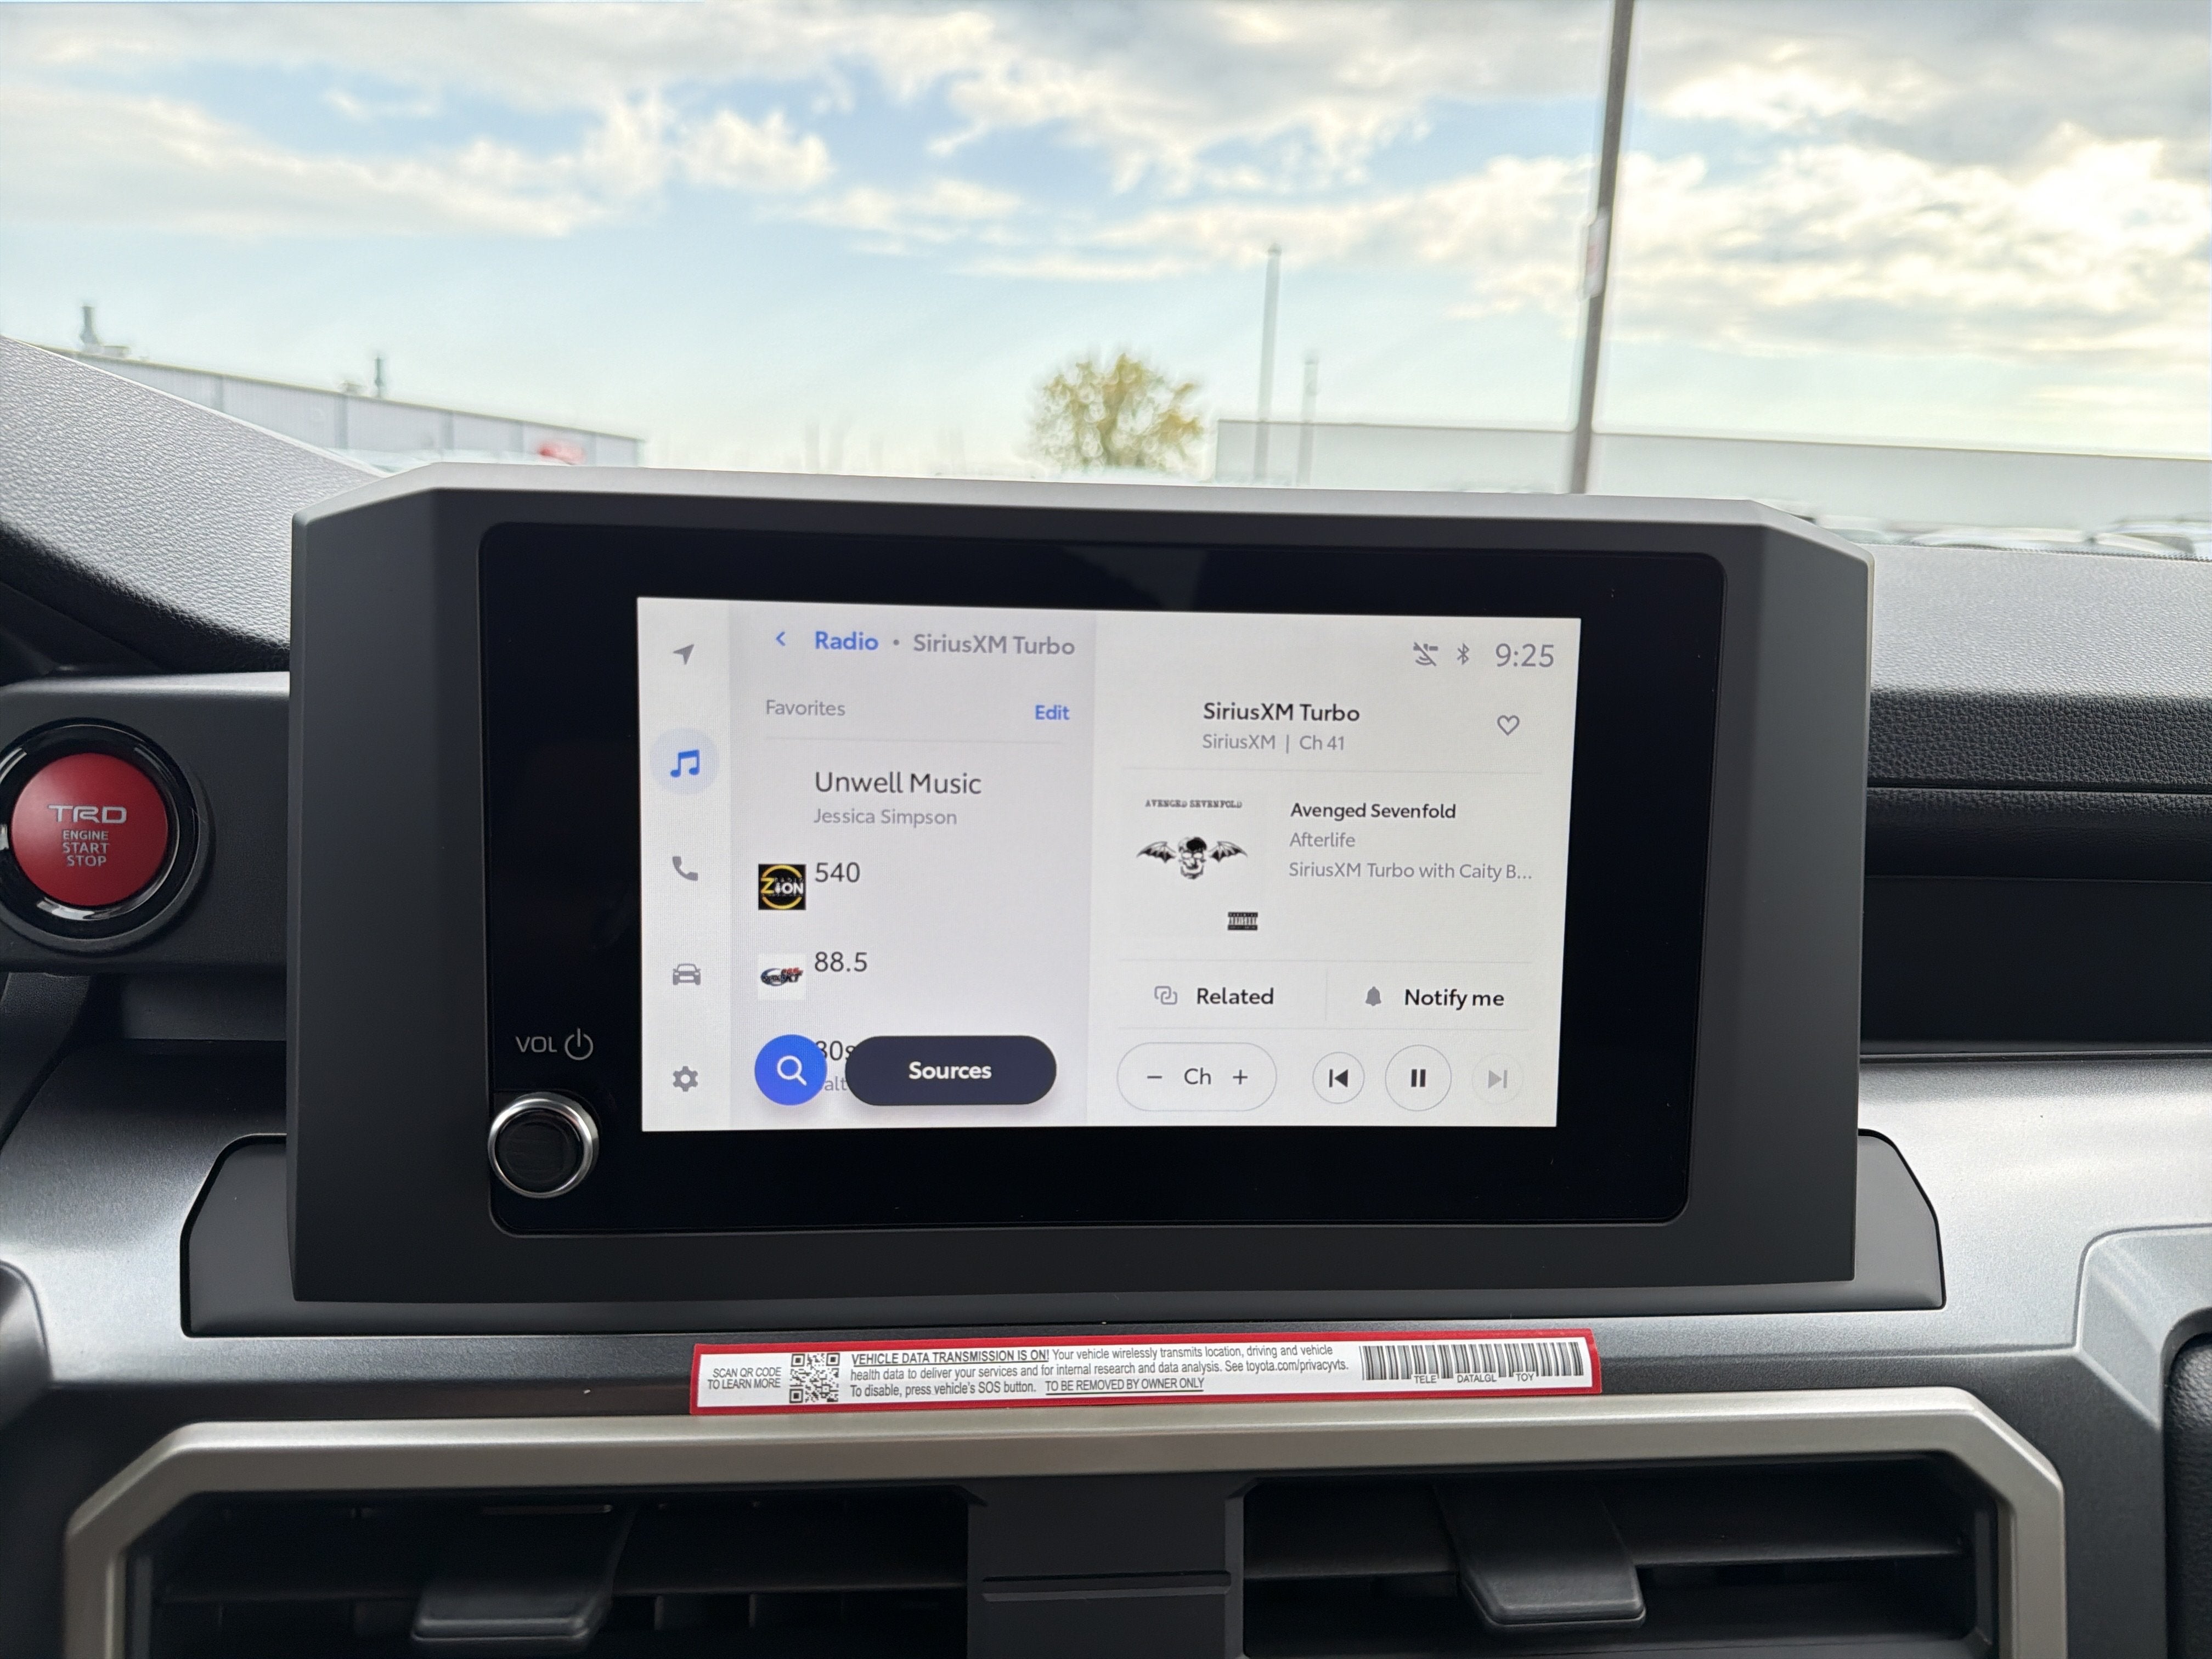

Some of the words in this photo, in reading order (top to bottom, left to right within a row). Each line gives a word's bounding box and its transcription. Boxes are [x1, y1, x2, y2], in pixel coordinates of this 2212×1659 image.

[815, 631, 879, 651] Radio
[913, 634, 1007, 654] SiriusXM
[1013, 636, 1075, 656] Turbo
[1495, 642, 1555, 668] 9:25
[766, 699, 846, 717] Favorites
[1035, 704, 1070, 721] Edit
[1203, 702, 1294, 722] SiriusXM
[1300, 703, 1360, 723] Turbo
[1202, 733, 1276, 751] SiriusXM
[1299, 735, 1324, 752] Ch
[1325, 735, 1345, 752] 41
[815, 771, 904, 794] Unwell
[910, 774, 982, 795] Music
[48, 804, 127, 824] TRD
[814, 808, 876, 825] Jessica
[880, 809, 958, 827] Simpson
[1290, 803, 1367, 820] Avenged
[1371, 803, 1457, 820] Sevenfold
[63, 830, 109, 841] ENGINE
[1289, 832, 1356, 848] Afterlife
[63, 842, 110, 854] START
[66, 855, 106, 867] STOP
[815, 862, 860, 884] 540
[1289, 862, 1362, 879] SiriusXM
[1367, 863, 1415, 879] Turbo
[1419, 863, 1455, 879] with
[1459, 864, 1502, 883] Caity
[814, 951, 868, 973] 88.5
[1197, 988, 1274, 1005] Related
[1404, 989, 1468, 1011] Notify
[1472, 994, 1505, 1007] me
[515, 1036, 557, 1053] VOL
[909, 1061, 992, 1081] Sources
[1184, 1068, 1212, 1086] Ch
[851, 1353, 899, 1365] VEHICLE
[902, 1352, 929, 1364] DATA
[933, 1350, 1014, 1363] TRANSMISSION
[1017, 1350, 1028, 1361] IS
[1030, 1349, 1049, 1361] ON!
[1052, 1349, 1074, 1360] Your
[1076, 1348, 1109, 1359] vehicle
[1112, 1347, 1158, 1361] wirelessly
[1160, 1346, 1203, 1358] transmits
[1205, 1346, 1244, 1358] location,
[1246, 1345, 1277, 1358] driving
[1280, 1345, 1297, 1356] and
[1300, 1344, 1333, 1355] vehicle
[713, 1368, 738, 1378] SCAN
[740, 1367, 754, 1377] QR
[755, 1367, 782, 1377] CODE
[851, 1368, 880, 1380] health
[883, 1368, 905, 1379] data
[908, 1368, 917, 1379] to
[920, 1367, 952, 1379] deliver
[955, 1368, 976, 1381] your
[978, 1365, 1018, 1378] services
[1020, 1364, 1039, 1376] and
[1041, 1364, 1054, 1375] for
[1057, 1363, 1091, 1375] internal
[1094, 1362, 1136, 1374] research
[1138, 1362, 1155, 1373] and
[1158, 1361, 1178, 1373] data
[1181, 1360, 1222, 1375] analysis.
[1224, 1359, 1244, 1372] See
[1246, 1358, 1349, 1375] toyota.com/privacyvts.
[1414, 1375, 1437, 1384] TELE
[1457, 1374, 1497, 1383] DATALGL
[1516, 1373, 1534, 1381] TOY
[707, 1379, 720, 1389] TO
[722, 1378, 752, 1389] LEARN
[754, 1378, 781, 1389] MORE
[850, 1384, 862, 1397] To
[864, 1383, 902, 1397] disable,
[905, 1385, 932, 1398] press
[934, 1381, 976, 1396] vehicle's
[978, 1380, 1001, 1393] SOS
[1003, 1380, 1036, 1393] button.
[1045, 1380, 1059, 1392] TO
[1061, 1380, 1074, 1391] BE
[1076, 1379, 1125, 1391] REMOVED
[1126, 1378, 1140, 1390] BY
[1141, 1378, 1178, 1389] OWNER
[1179, 1377, 1205, 1389] ONLY
